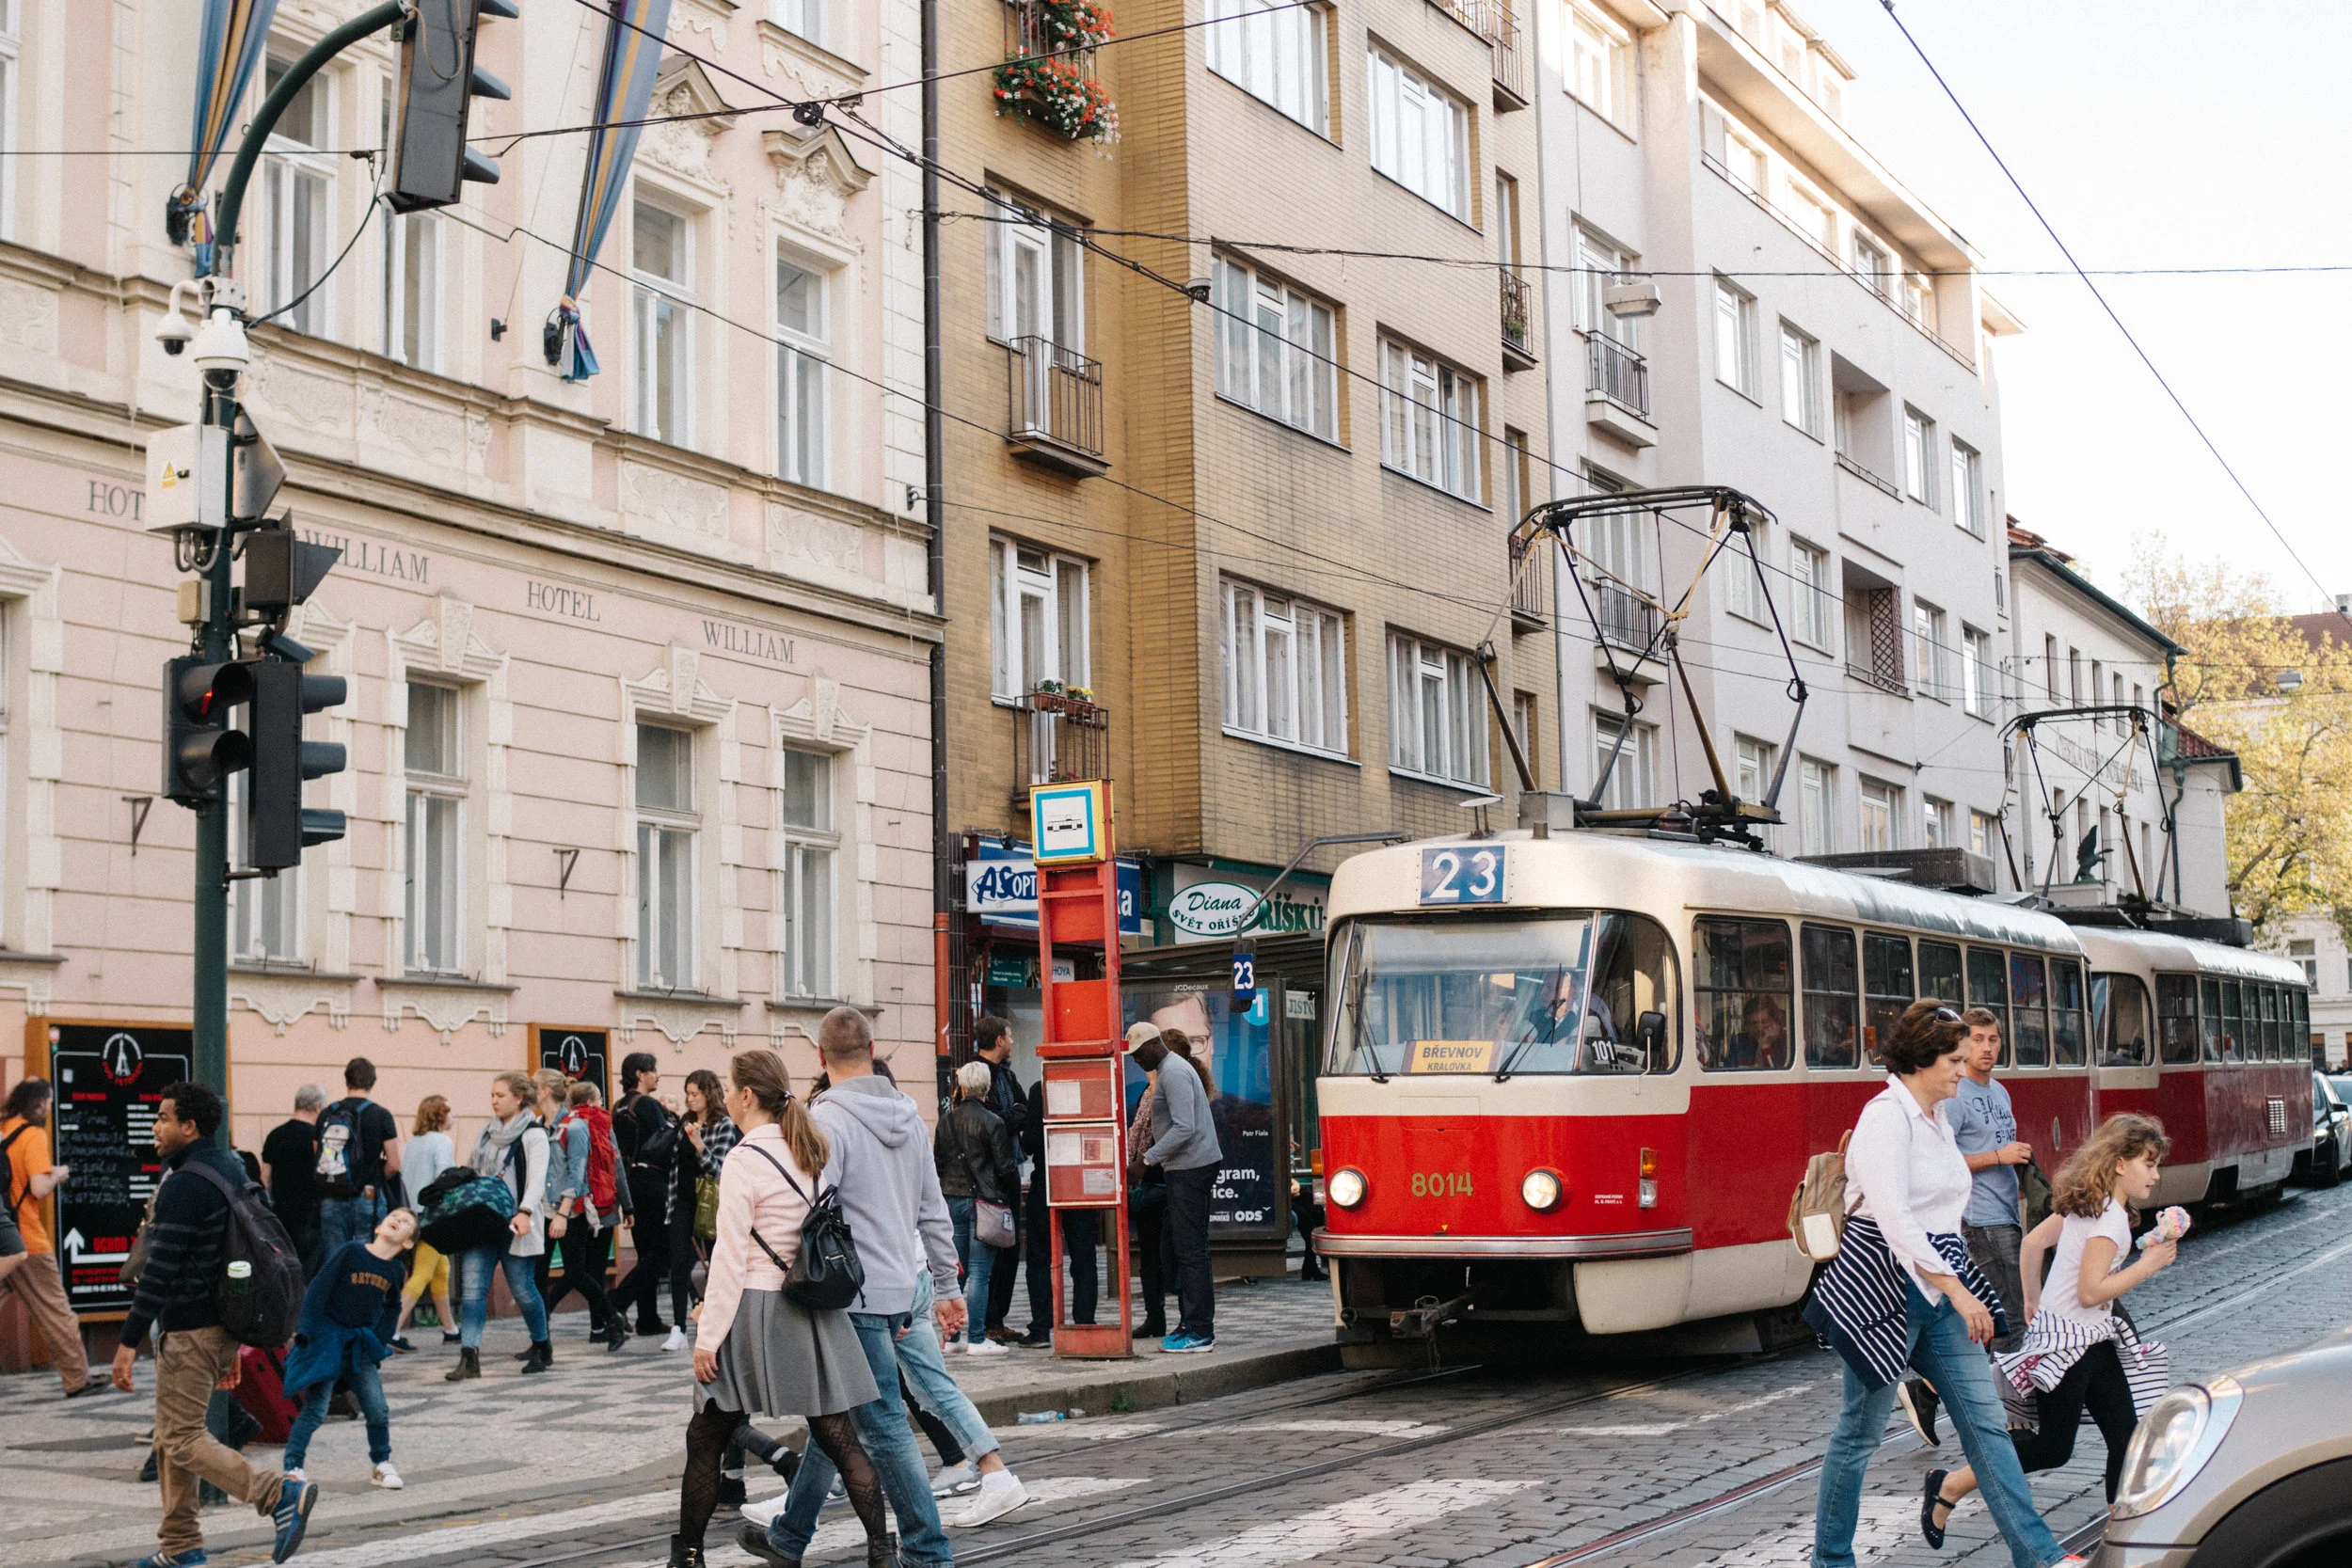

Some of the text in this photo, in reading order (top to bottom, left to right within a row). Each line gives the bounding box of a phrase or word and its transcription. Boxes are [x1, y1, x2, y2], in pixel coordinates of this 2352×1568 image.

[88, 480, 146, 521] HOT
[527, 580, 794, 663] HOTEL WILLIAM
[1430, 850, 1496, 898] 23
[1012, 875, 1038, 896] OPT
[1187, 892, 1243, 911] Diana
[1172, 909, 1203, 930] SVĚT
[1233, 960, 1255, 990] 23
[1173, 984, 1210, 992] JCDecaux
[1422, 1044, 1484, 1058] BŘEVNOV
[1591, 1040, 1616, 1061] 101
[1216, 1168, 1261, 1184] gram,
[1411, 1172, 1473, 1197] 8014
[1212, 1184, 1239, 1199] ice.
[1234, 1210, 1263, 1222] ODS
